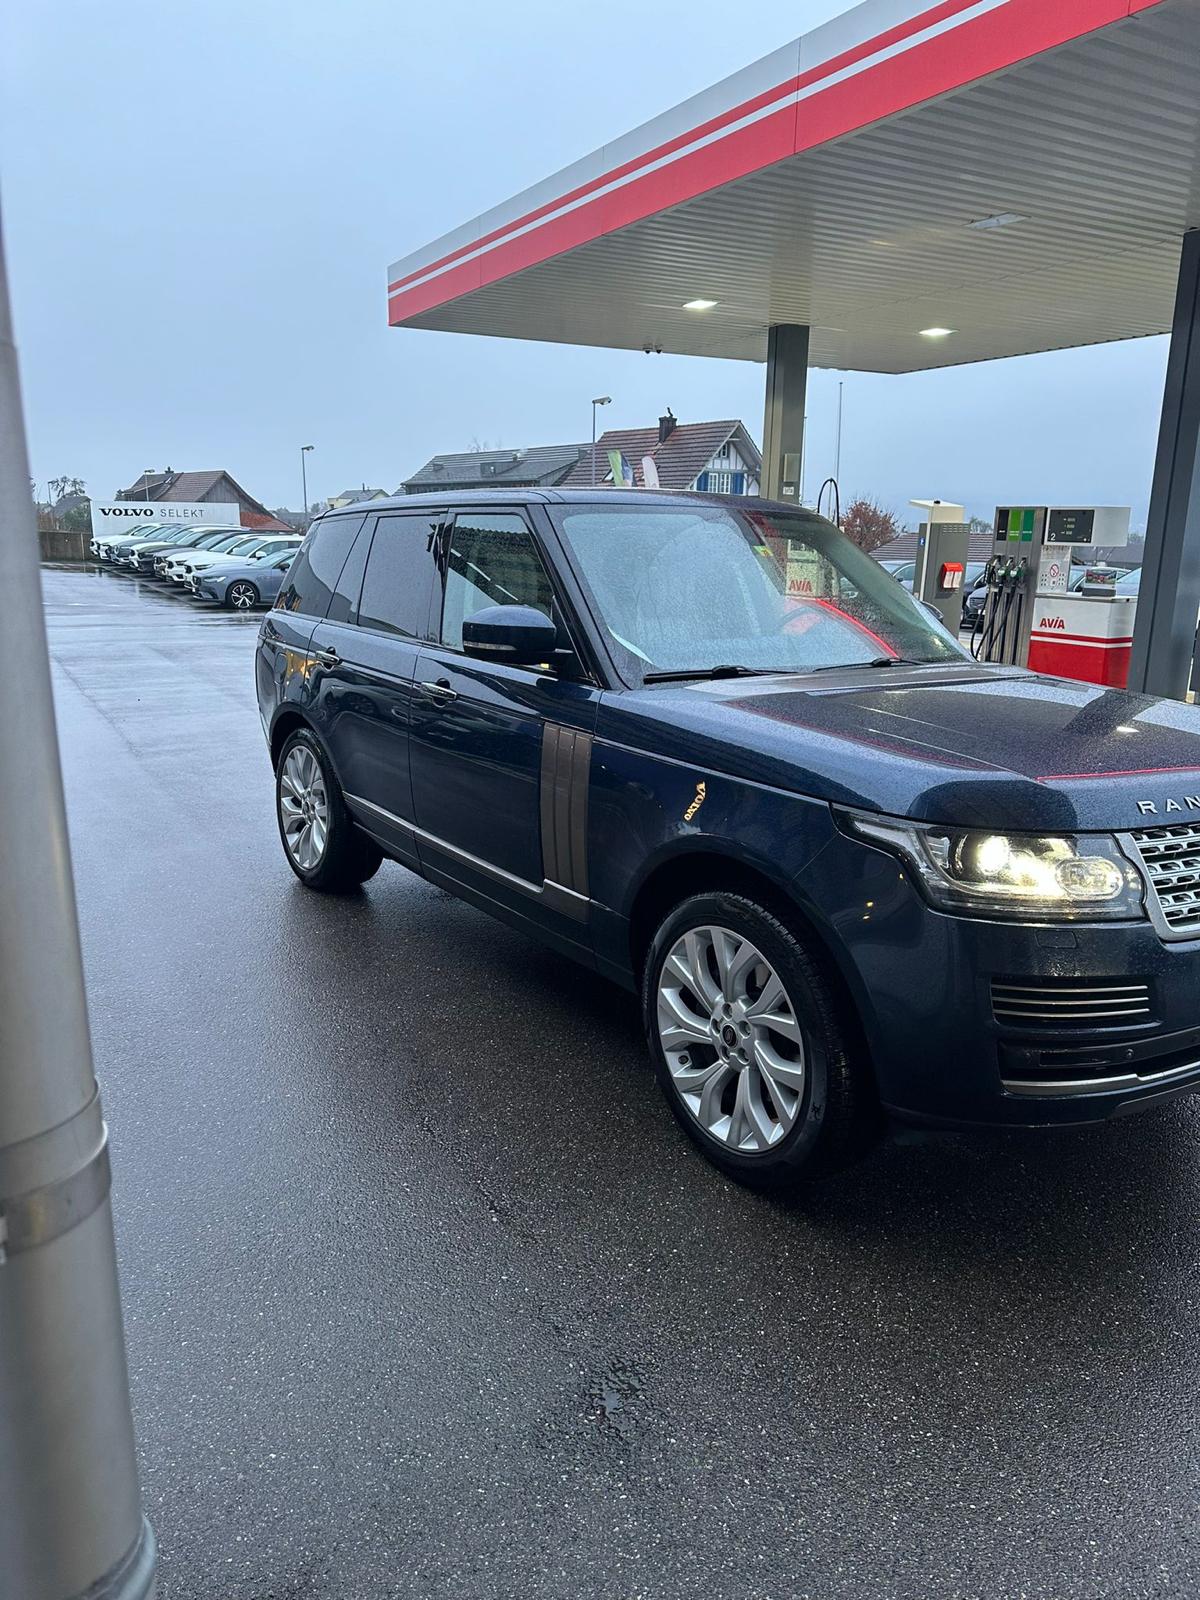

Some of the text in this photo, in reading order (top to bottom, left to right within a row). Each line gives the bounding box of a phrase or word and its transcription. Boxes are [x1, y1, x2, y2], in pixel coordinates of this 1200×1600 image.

[99, 508, 205, 518] VOLVO SELEKT
[1050, 532, 1056, 541] 2
